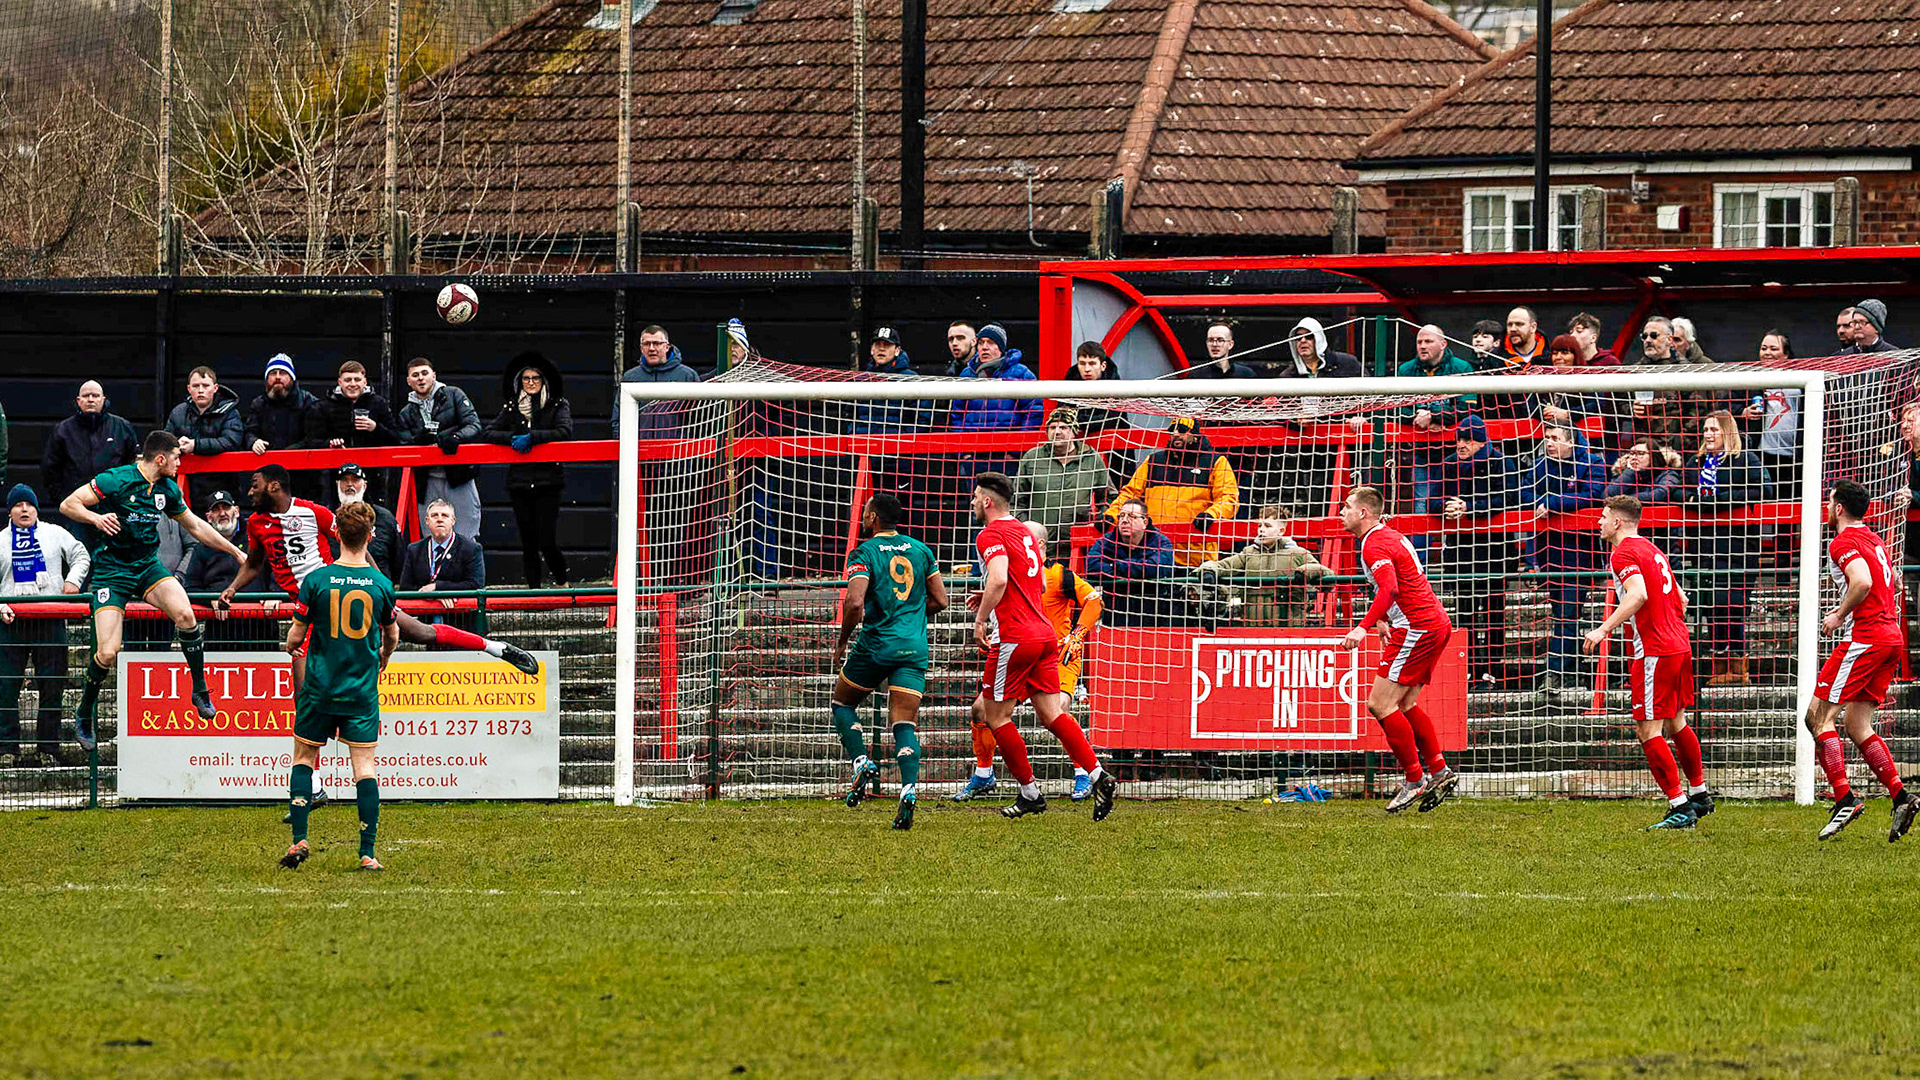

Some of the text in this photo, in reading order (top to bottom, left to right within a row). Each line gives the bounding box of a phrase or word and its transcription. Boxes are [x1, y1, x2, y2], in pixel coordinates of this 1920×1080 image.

[1023, 536, 1039, 577] 5
[1654, 553, 1672, 595] 3
[1875, 545, 1891, 588] 8
[330, 576, 346, 586] Bay
[889, 555, 914, 602] 9
[330, 589, 374, 640] 10
[141, 667, 294, 699] LITLE
[379, 672, 539, 685] PERTY CONSULTANTS
[1216, 649, 1335, 688] PITCHING
[378, 693, 536, 706] OMMERCIAL AGENTS
[1272, 689, 1299, 728] IN
[141, 710, 296, 730] &ASSOCIAT
[394, 720, 438, 736] 0161
[446, 720, 478, 736] 237
[486, 719, 532, 736] 1873
[189, 752, 235, 766] email:
